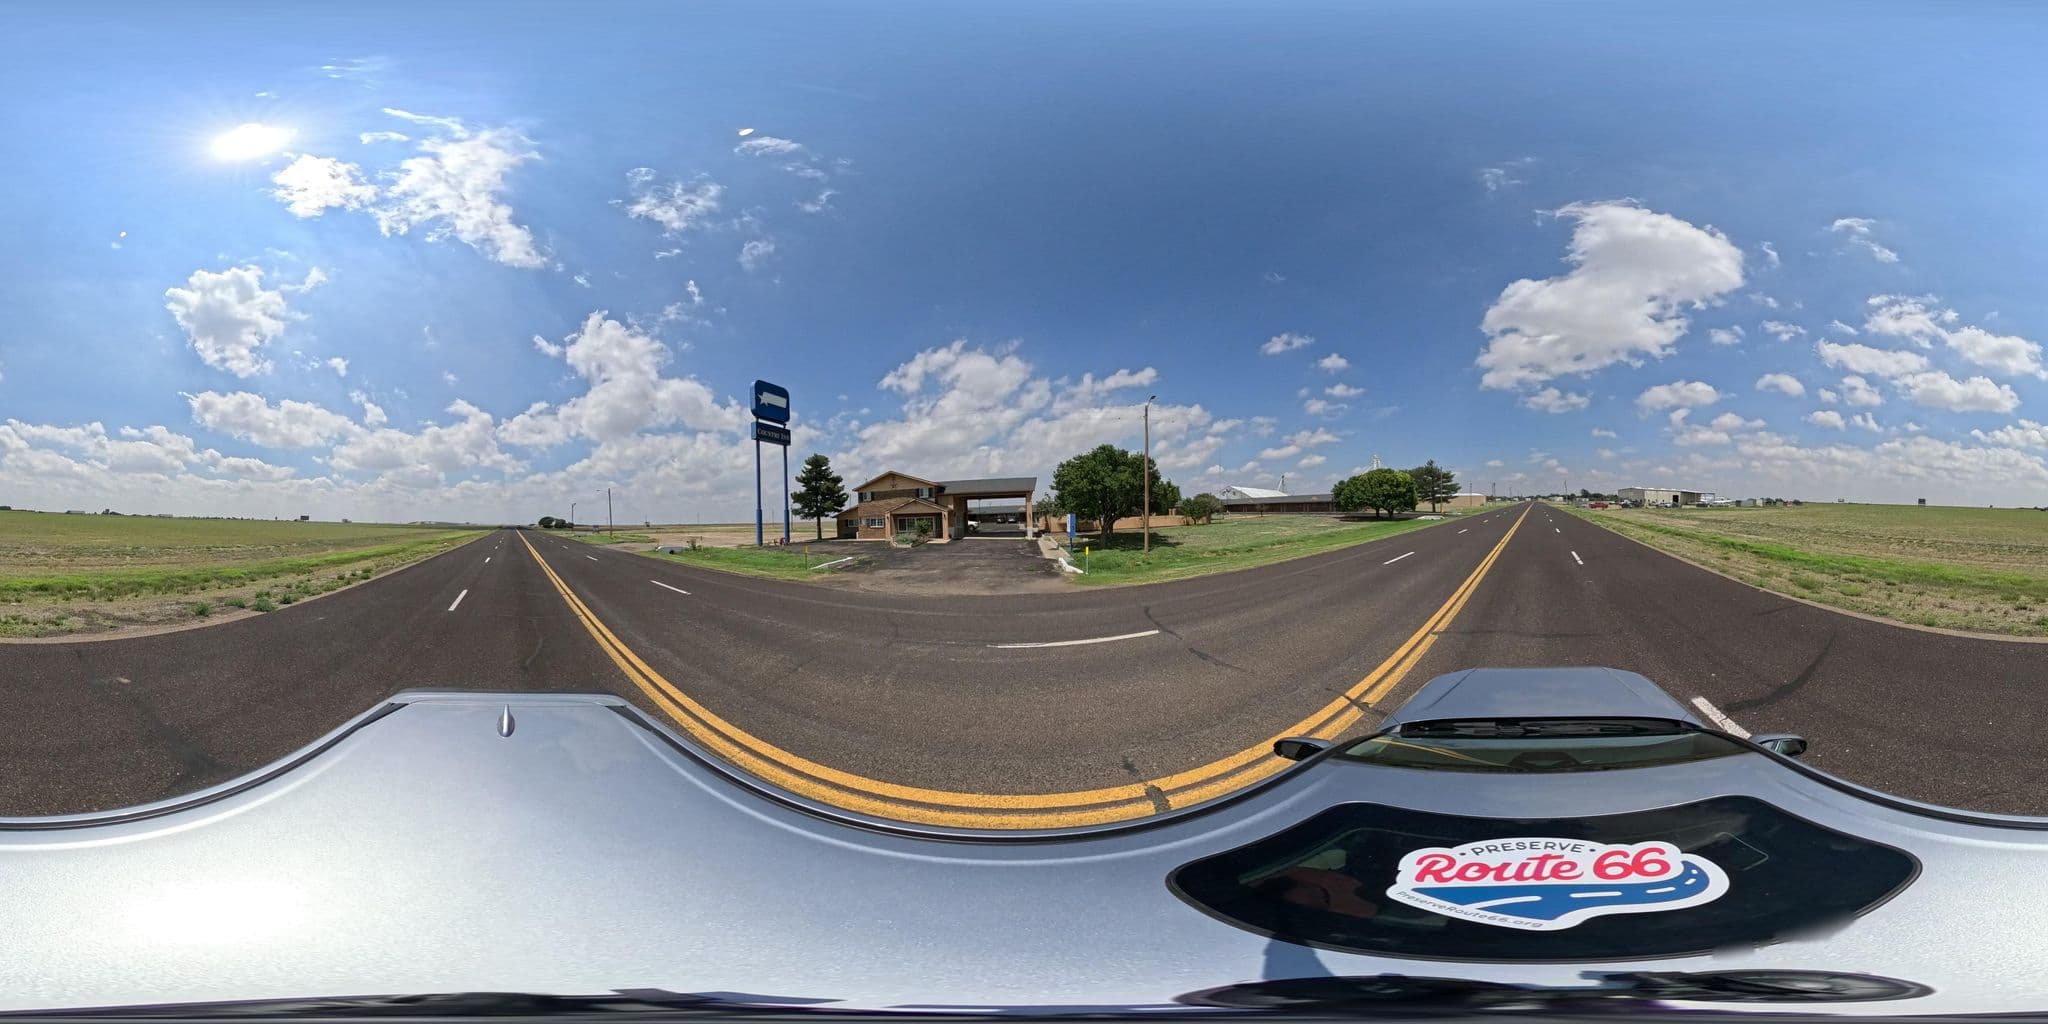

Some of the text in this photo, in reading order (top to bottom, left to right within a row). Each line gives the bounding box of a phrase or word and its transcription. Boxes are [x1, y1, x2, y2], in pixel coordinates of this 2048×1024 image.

[1415, 847, 1671, 883] Route 66
[1471, 841, 1585, 856] PRESERVE
[1397, 890, 1543, 928] PreserveRoute66.org
